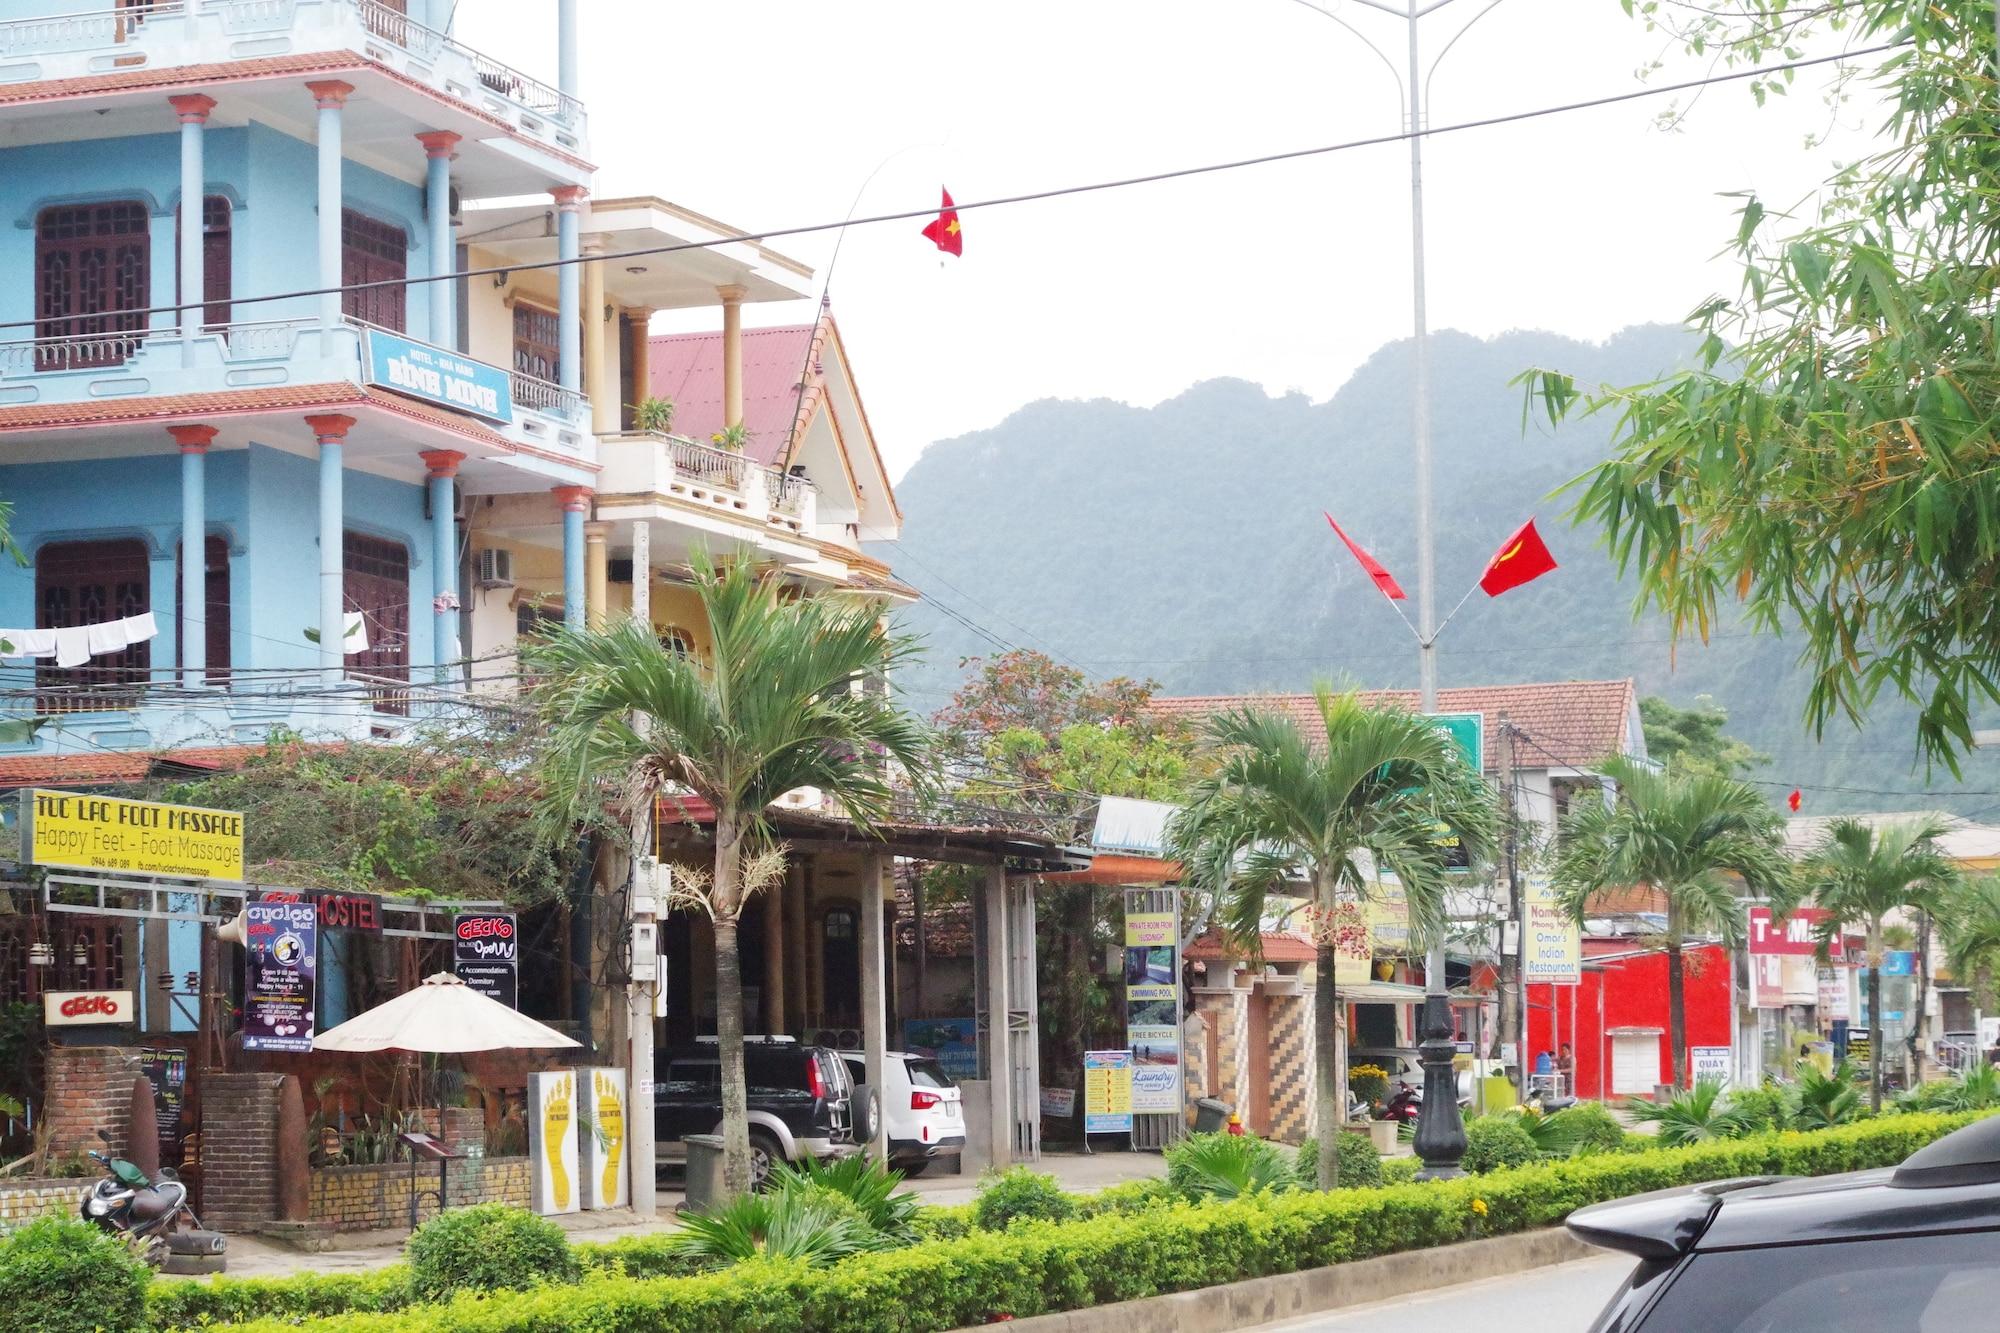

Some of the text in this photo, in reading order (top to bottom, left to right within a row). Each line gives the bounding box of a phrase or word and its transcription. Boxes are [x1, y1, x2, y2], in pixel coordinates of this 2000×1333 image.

[410, 349, 433, 366] HOTEL
[36, 795, 241, 837] TUC LAC FOOT MASSAGE
[35, 821, 88, 855] Happy
[93, 827, 125, 852] Feet
[141, 832, 174, 856] Foot
[178, 835, 240, 867] Massage
[91, 856, 106, 867] 0946
[107, 857, 118, 868] 689
[119, 858, 130, 869] 089
[292, 921, 313, 930] bar
[457, 917, 513, 940] GECKO
[1752, 917, 1770, 943] T
[1538, 946, 1565, 959] Indian
[464, 966, 508, 974] Accommodation:
[1529, 960, 1575, 973] Restaurant
[468, 977, 495, 986] Dormitory
[1131, 988, 1173, 998] SWIMMING POOL
[60, 995, 118, 1018] GECKO
[1132, 1031, 1174, 1039] FREE BICYCLE
[1133, 1068, 1175, 1086] Laundry
